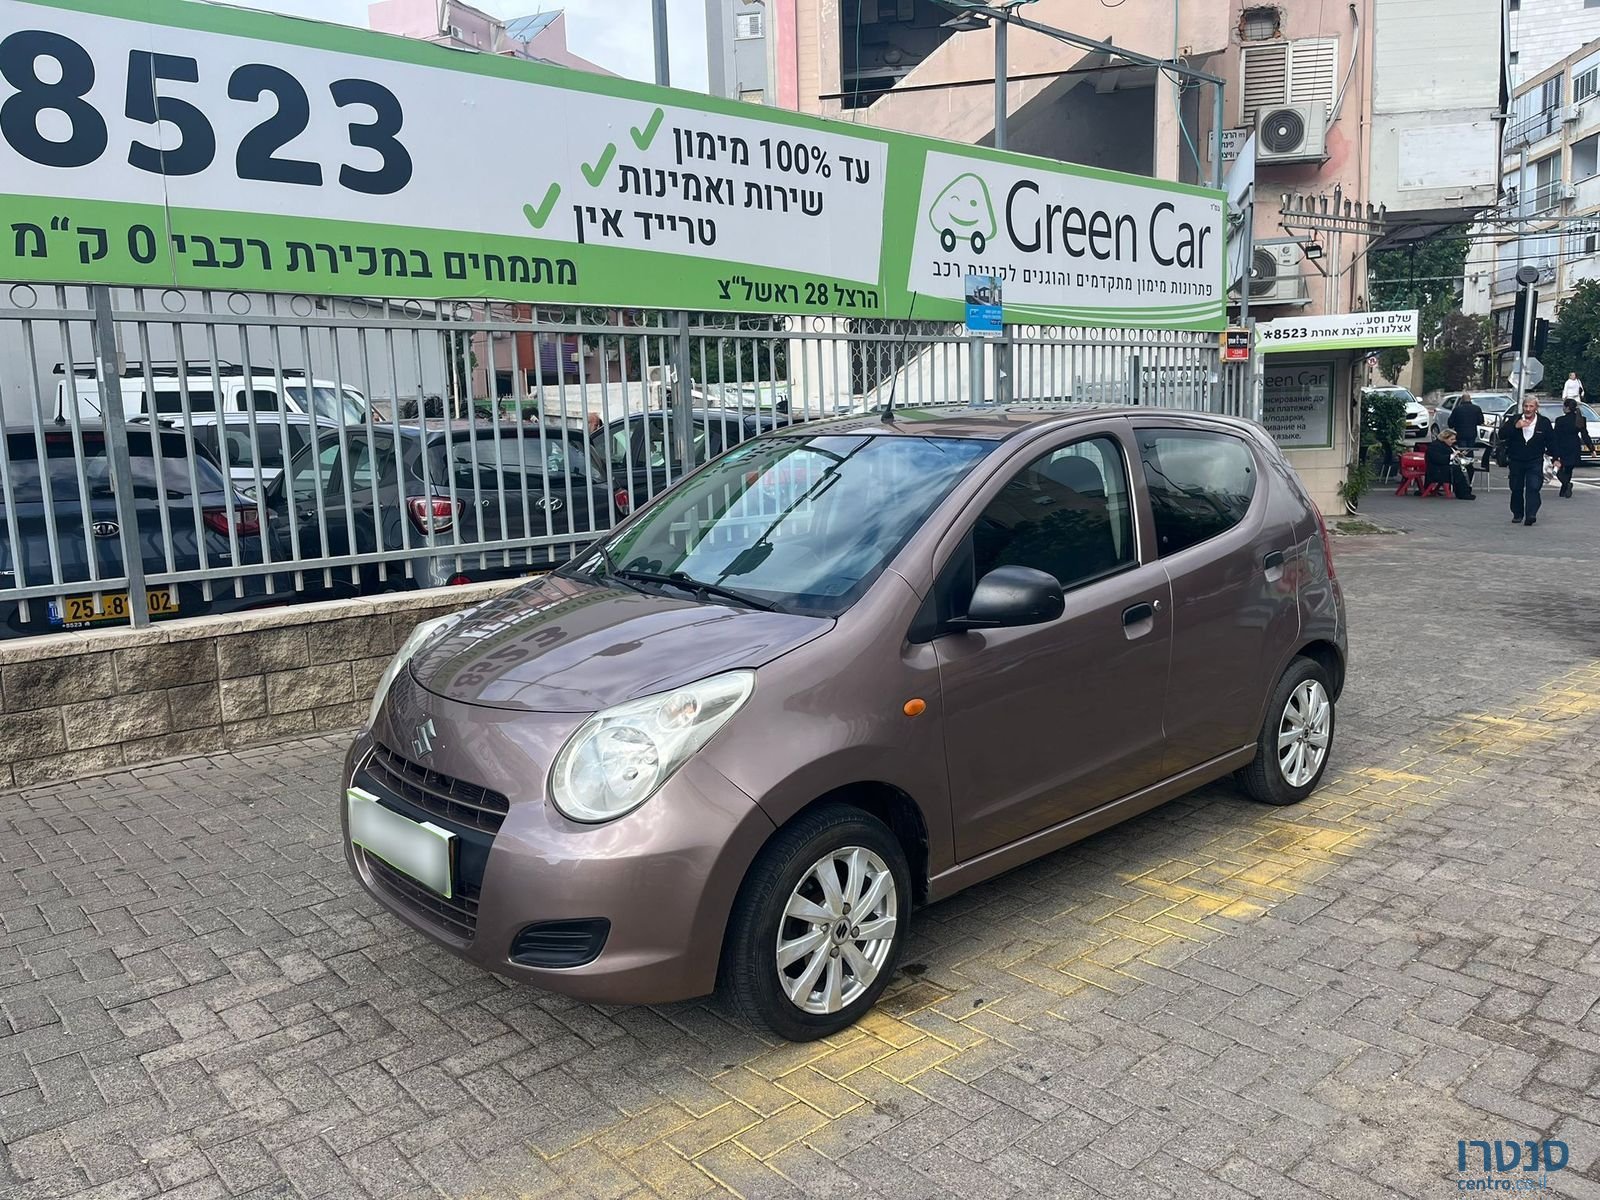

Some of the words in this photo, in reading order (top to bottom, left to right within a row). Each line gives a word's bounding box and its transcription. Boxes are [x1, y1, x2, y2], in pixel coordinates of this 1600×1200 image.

[672, 126, 750, 166] מימון
[759, 137, 831, 180] 100%
[838, 155, 871, 184] עד
[618, 164, 735, 206] ואמינות
[743, 181, 825, 217] שירות
[573, 204, 625, 244] אין
[633, 210, 717, 247] טרייד
[1005, 179, 1138, 263] Green
[1149, 201, 1211, 269] Car
[127, 224, 157, 264] 0
[171, 234, 272, 271] רכבי
[286, 240, 433, 280] במכירת
[443, 250, 577, 286] מתמחים
[933, 261, 961, 278] רכב
[1023, 268, 1071, 287] והוגנים
[1076, 273, 1133, 293] מתקדמים
[1137, 278, 1167, 295] מימון
[1170, 281, 1213, 297] פתרונות
[804, 282, 829, 306] 28
[833, 283, 879, 310] הרצל
[1343, 327, 1364, 337] קצת
[1367, 326, 1379, 335] זה
[1382, 324, 1412, 334] אצלנו
[1388, 314, 1412, 323] שלם
[1310, 328, 1339, 338] אחרת
[1264, 375, 1294, 387] een
[1297, 371, 1326, 386] Car
